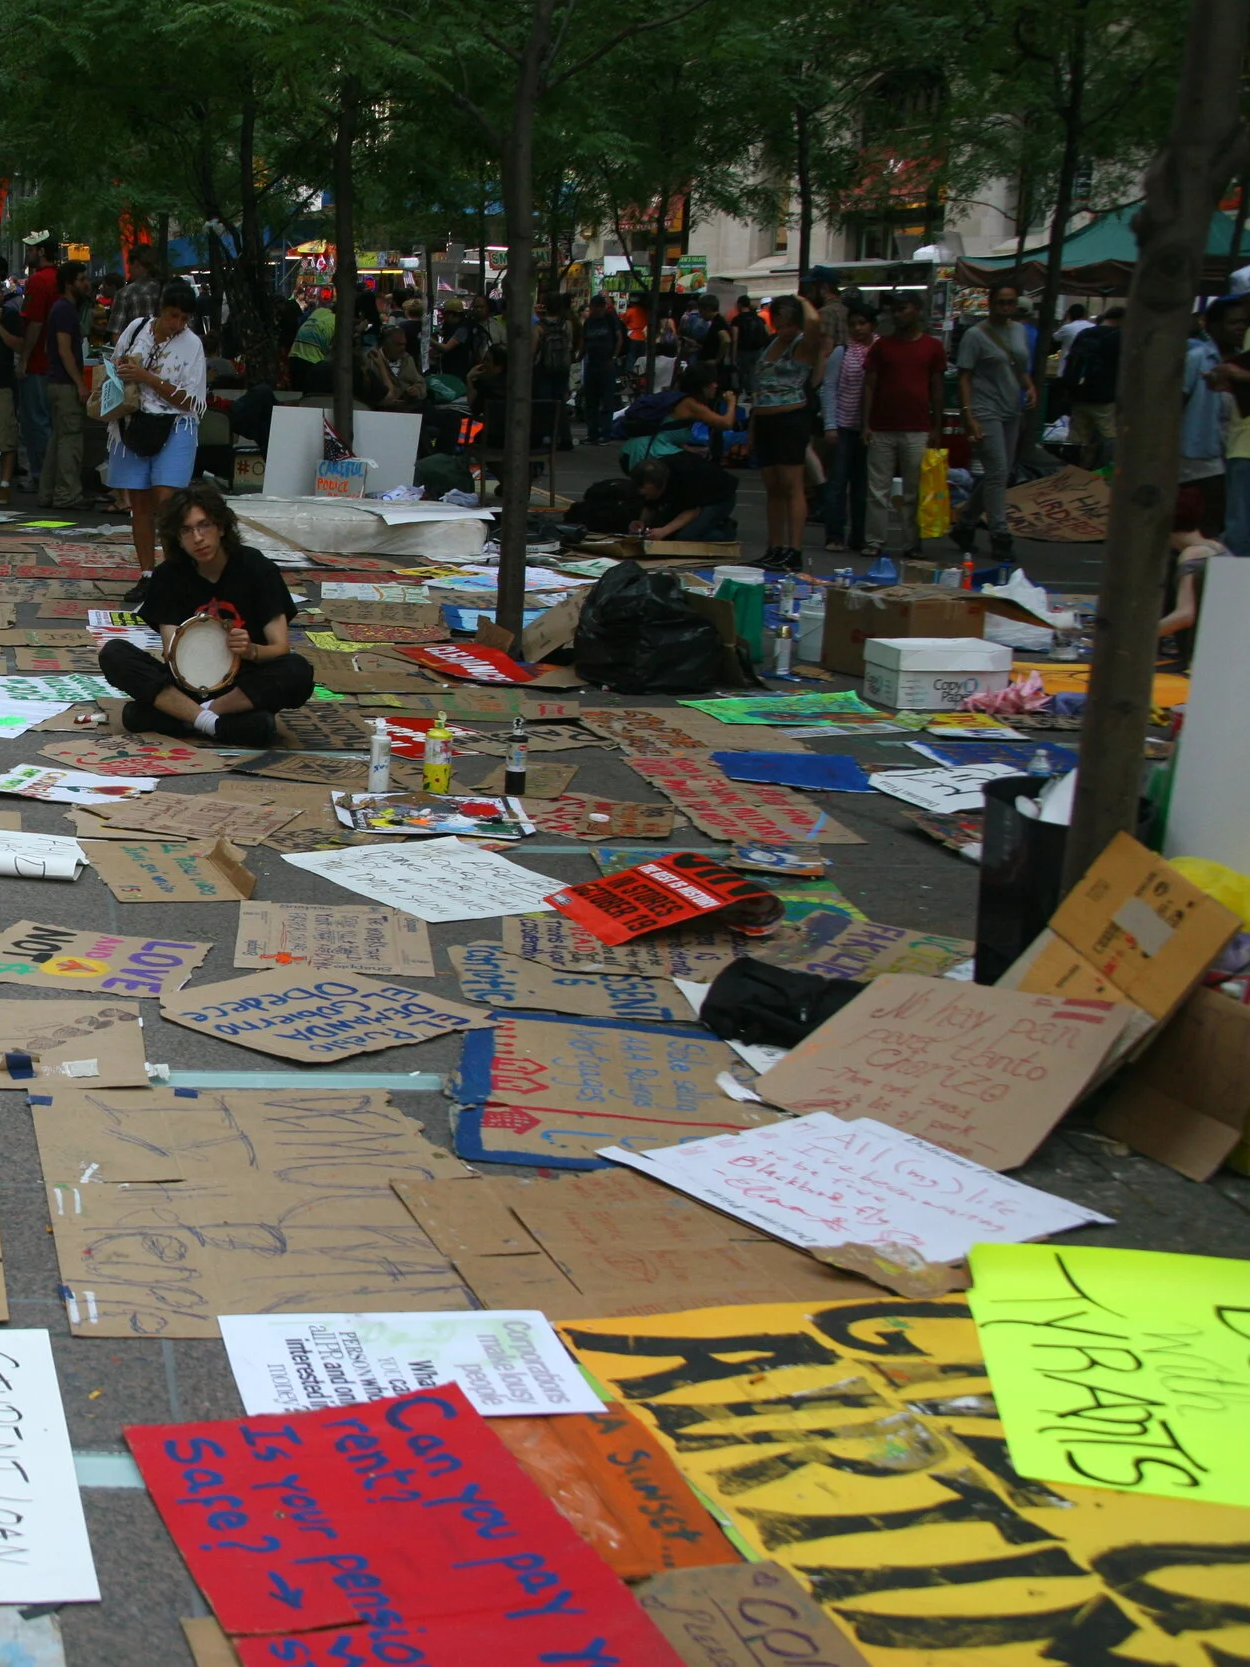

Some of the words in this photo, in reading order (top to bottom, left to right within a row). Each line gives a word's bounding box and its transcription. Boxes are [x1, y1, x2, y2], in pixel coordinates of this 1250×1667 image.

[932, 678, 963, 694] Copy
[940, 690, 972, 704] Pape
[569, 881, 641, 918] OCTOBER
[617, 913, 659, 931] 19
[616, 882, 687, 918] STORES
[4, 926, 76, 966] NOT
[80, 934, 128, 962] AND
[102, 941, 195, 993] LOVE
[175, 980, 360, 1022] Obedece
[358, 985, 419, 1001] EL
[211, 999, 369, 1035] Gobierno
[270, 1002, 434, 1042] DEMANDA
[409, 1012, 469, 1031] EL
[953, 1035, 1048, 1082] tanto
[285, 1338, 324, 1400] interested
[323, 1361, 350, 1385] and
[339, 1331, 374, 1380] PERSON
[407, 1360, 438, 1389] Wha
[476, 1334, 515, 1374] make
[504, 1370, 540, 1406] lousy
[502, 1320, 572, 1404] Corporations
[453, 1363, 504, 1406] people
[239, 1424, 302, 1462] Is
[384, 1395, 463, 1477] Can
[329, 1418, 435, 1503] rent?
[164, 1437, 281, 1553] Safe?
[253, 1473, 337, 1539] your
[407, 1482, 515, 1540] you
[453, 1552, 583, 1620] pay
